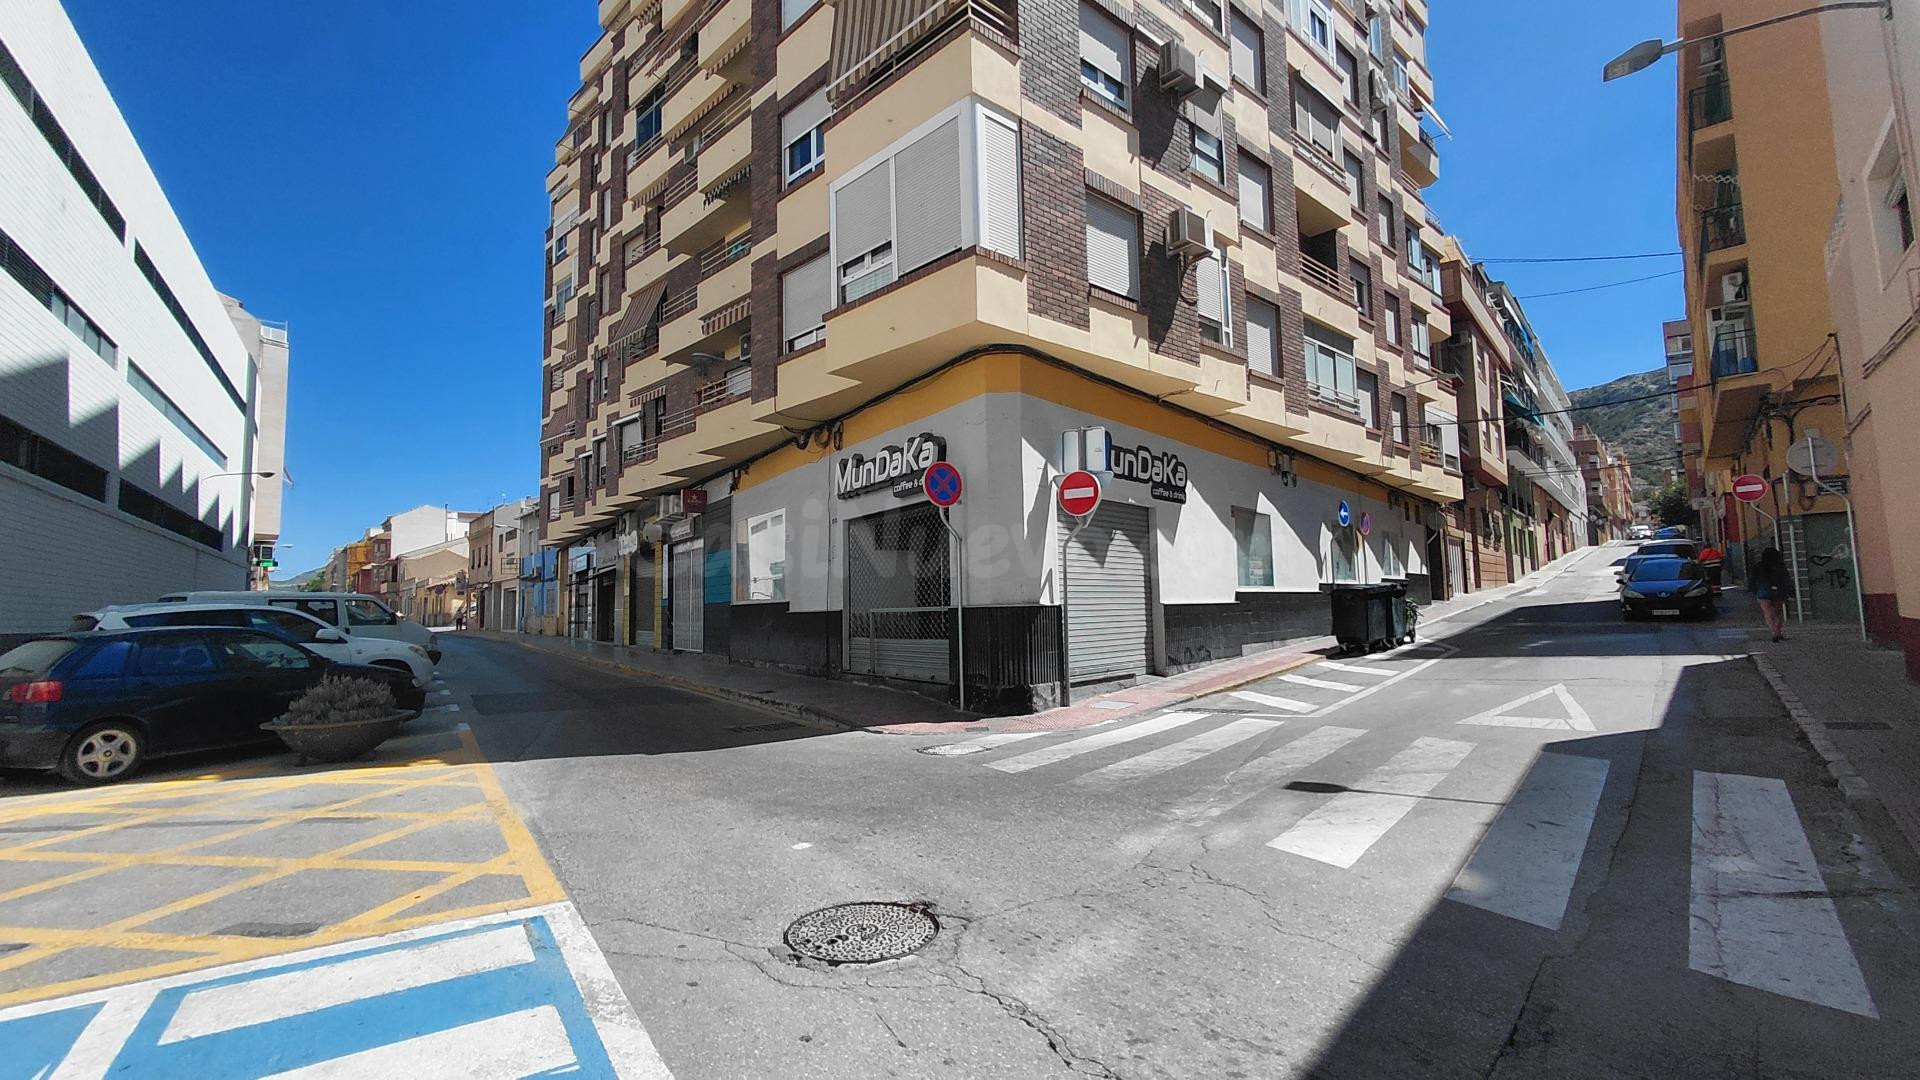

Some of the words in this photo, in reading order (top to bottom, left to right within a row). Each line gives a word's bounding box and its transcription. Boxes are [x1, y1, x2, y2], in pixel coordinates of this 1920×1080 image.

[835, 437, 934, 495] MunDaKa
[1110, 449, 1186, 487] unDaKa
[893, 480, 912, 493] coffee
